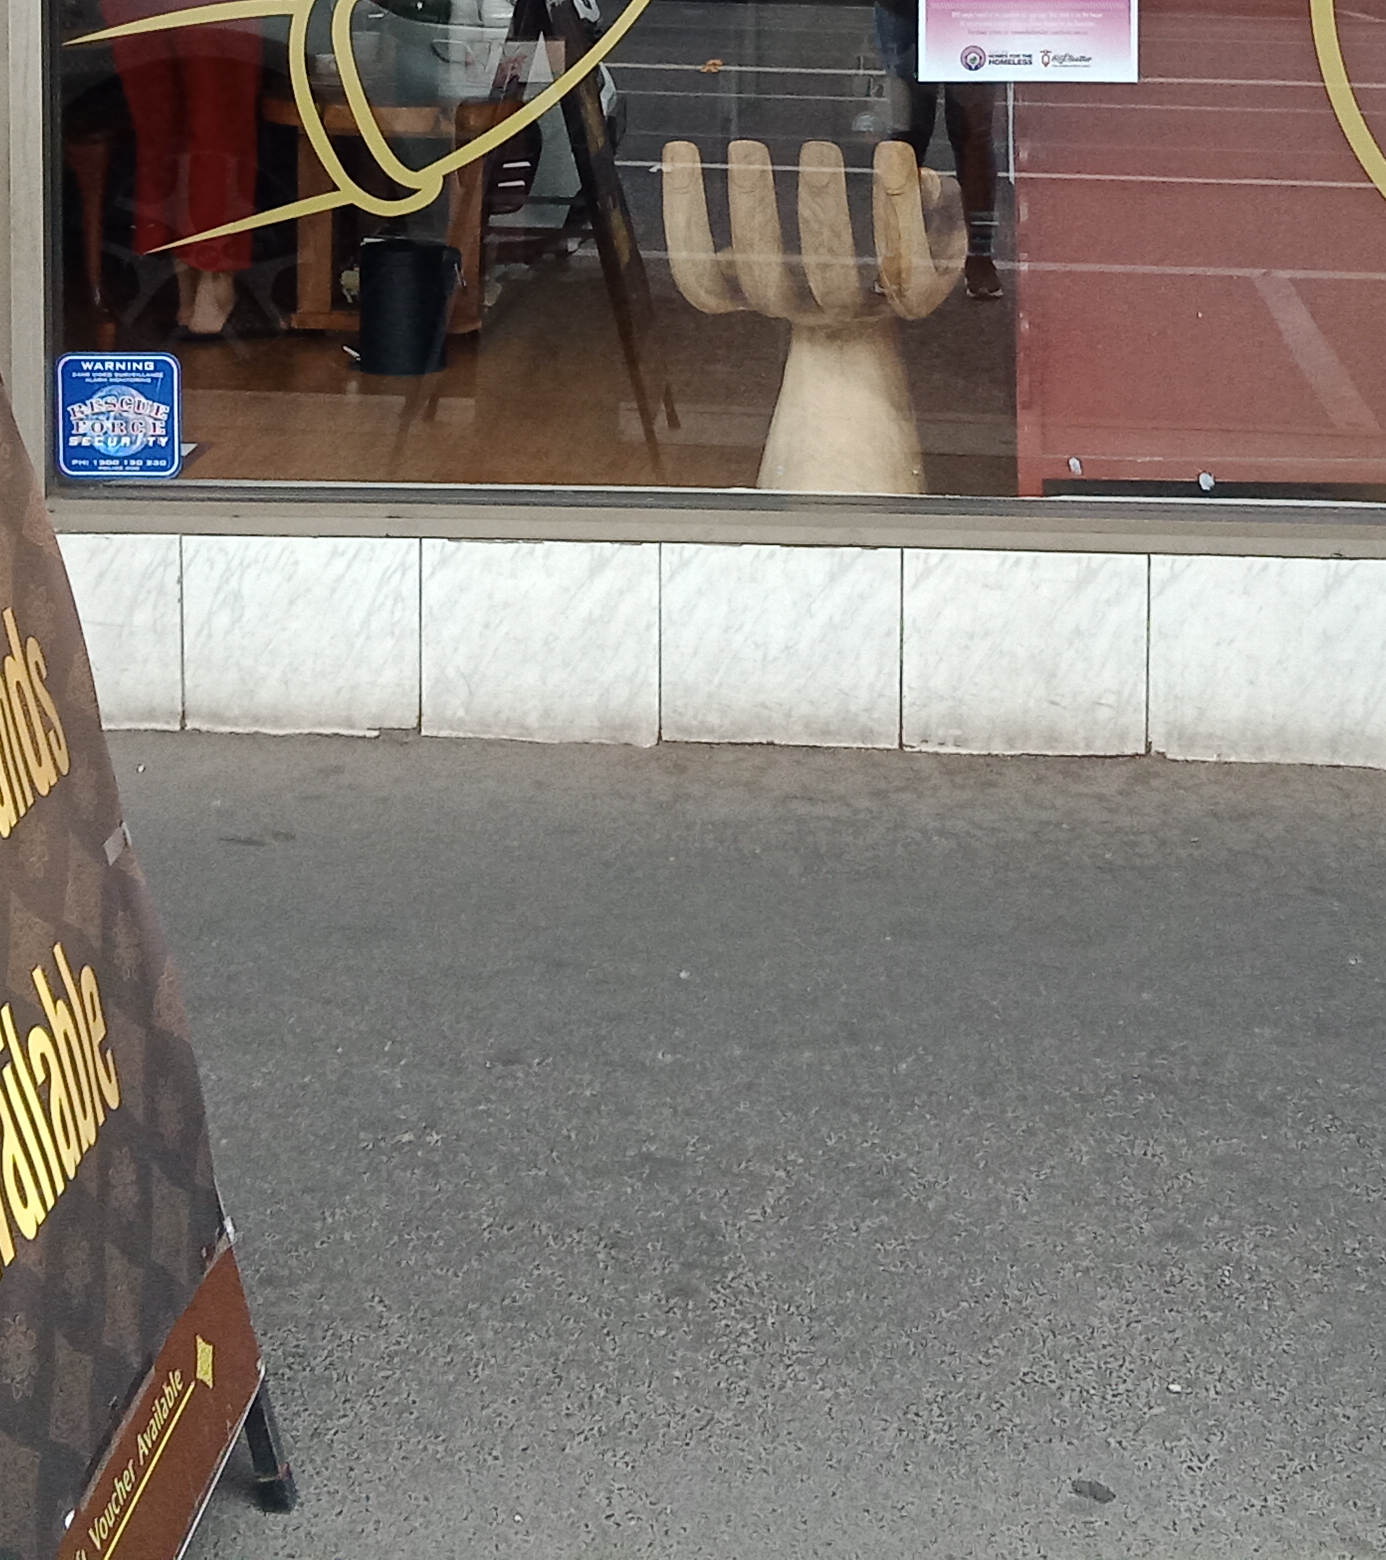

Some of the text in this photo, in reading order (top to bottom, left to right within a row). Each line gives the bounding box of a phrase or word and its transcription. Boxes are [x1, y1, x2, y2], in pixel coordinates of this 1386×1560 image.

[81, 361, 154, 371] WARNING
[67, 395, 170, 421] RESCUE
[71, 419, 167, 436] FORCE
[68, 436, 170, 448] SECURITY
[88, 1368, 184, 1551] Voucher Available
